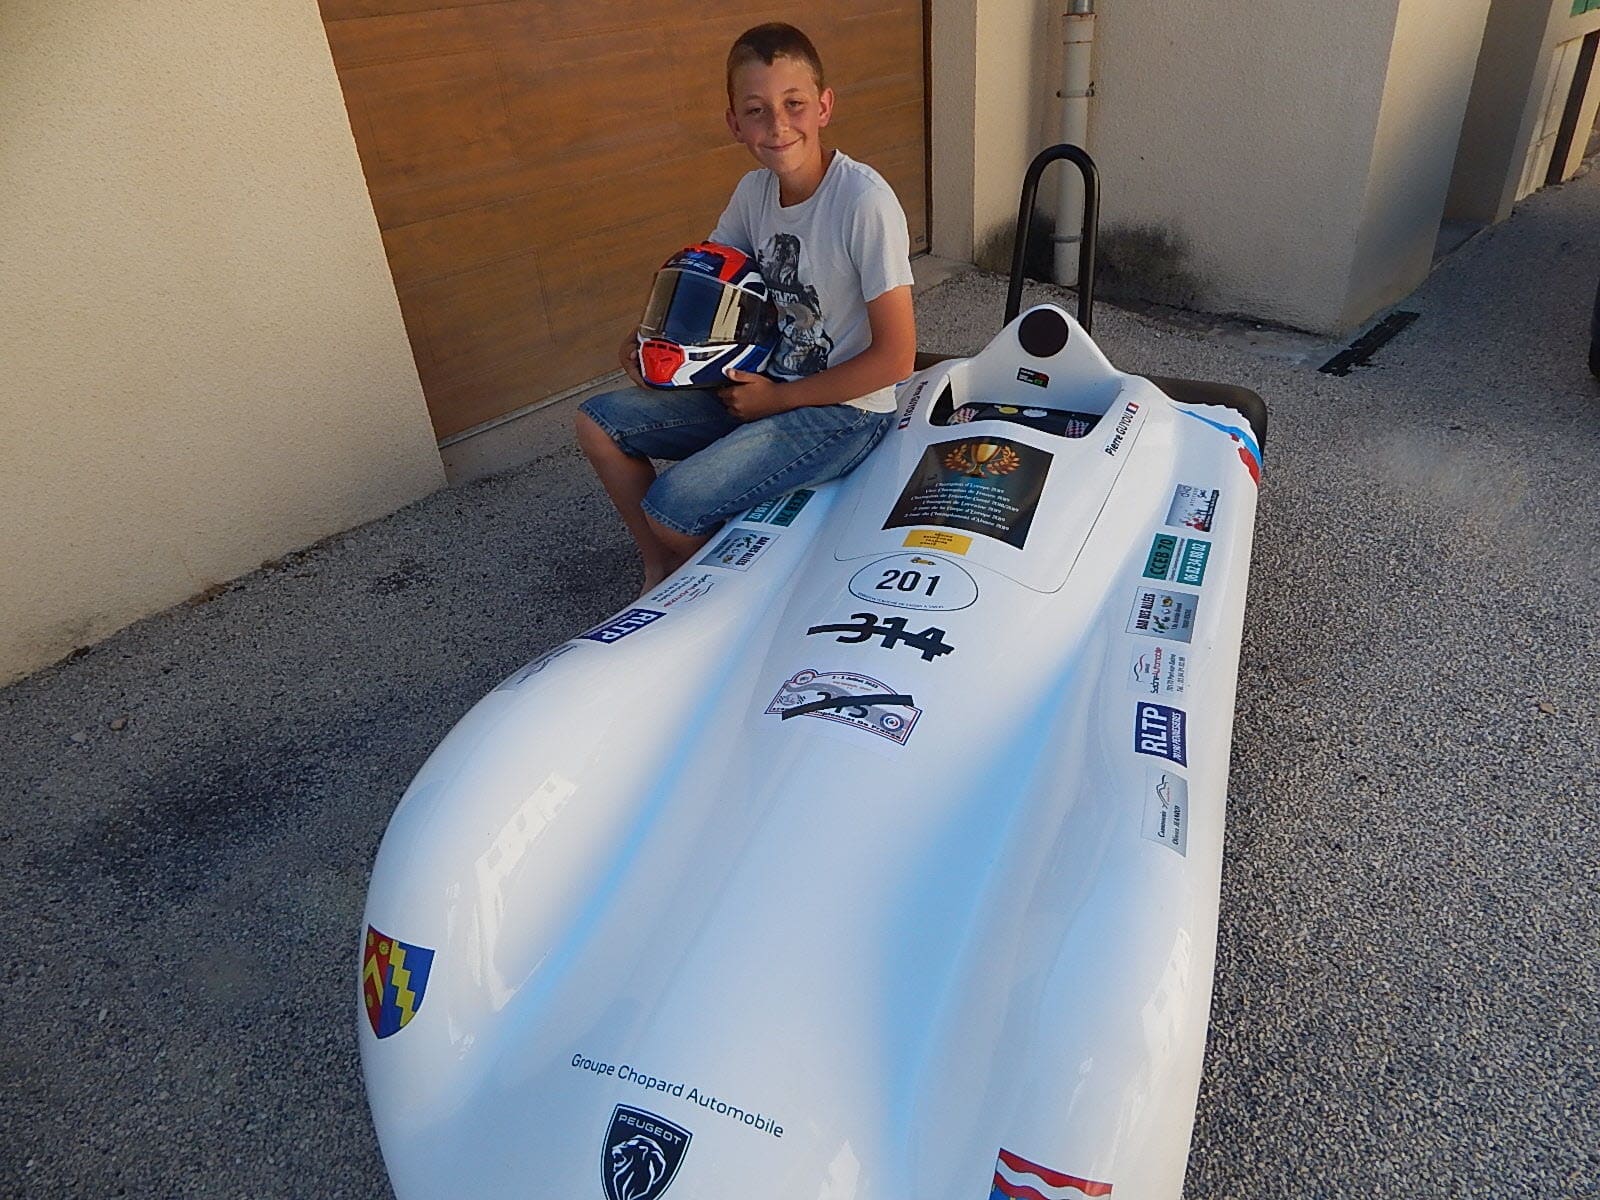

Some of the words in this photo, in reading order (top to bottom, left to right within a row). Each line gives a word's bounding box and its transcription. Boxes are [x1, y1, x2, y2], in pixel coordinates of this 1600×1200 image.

[1105, 435, 1124, 457] Pierre
[1117, 411, 1134, 434] GUYOU
[1157, 539, 1173, 550] 70
[1150, 551, 1170, 575] CCEB
[875, 569, 941, 597] 201
[601, 612, 658, 640] RLTP
[1141, 706, 1168, 755] RLTP
[571, 1053, 615, 1076] Groupe
[617, 1065, 685, 1097] Chopard
[686, 1088, 784, 1138] Automobile
[618, 1114, 682, 1145] PEUGEOT
